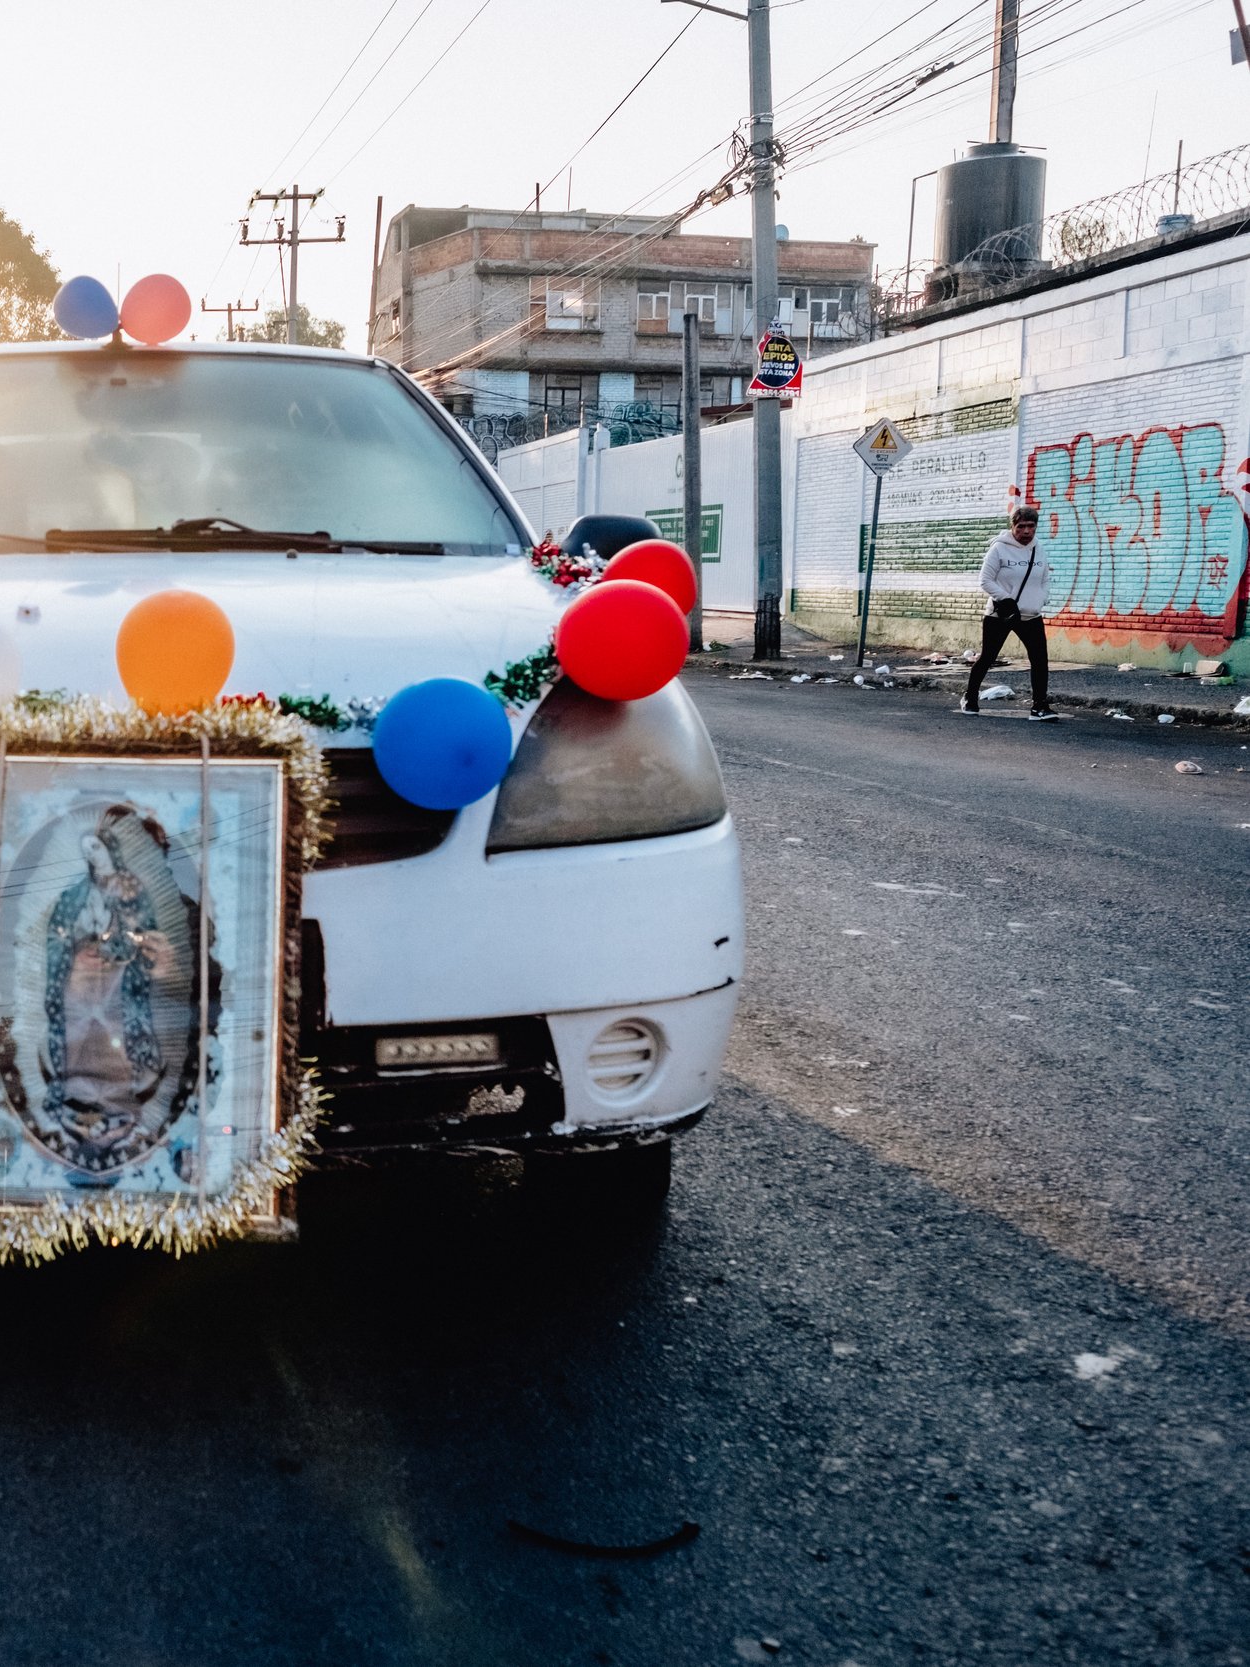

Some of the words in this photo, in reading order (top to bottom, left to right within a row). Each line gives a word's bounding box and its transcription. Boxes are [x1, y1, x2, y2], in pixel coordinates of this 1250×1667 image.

[767, 343, 791, 352] ENTA
[763, 352, 795, 362] EPTOS
[758, 368, 773, 376] STA
[774, 369, 794, 377] ZONA
